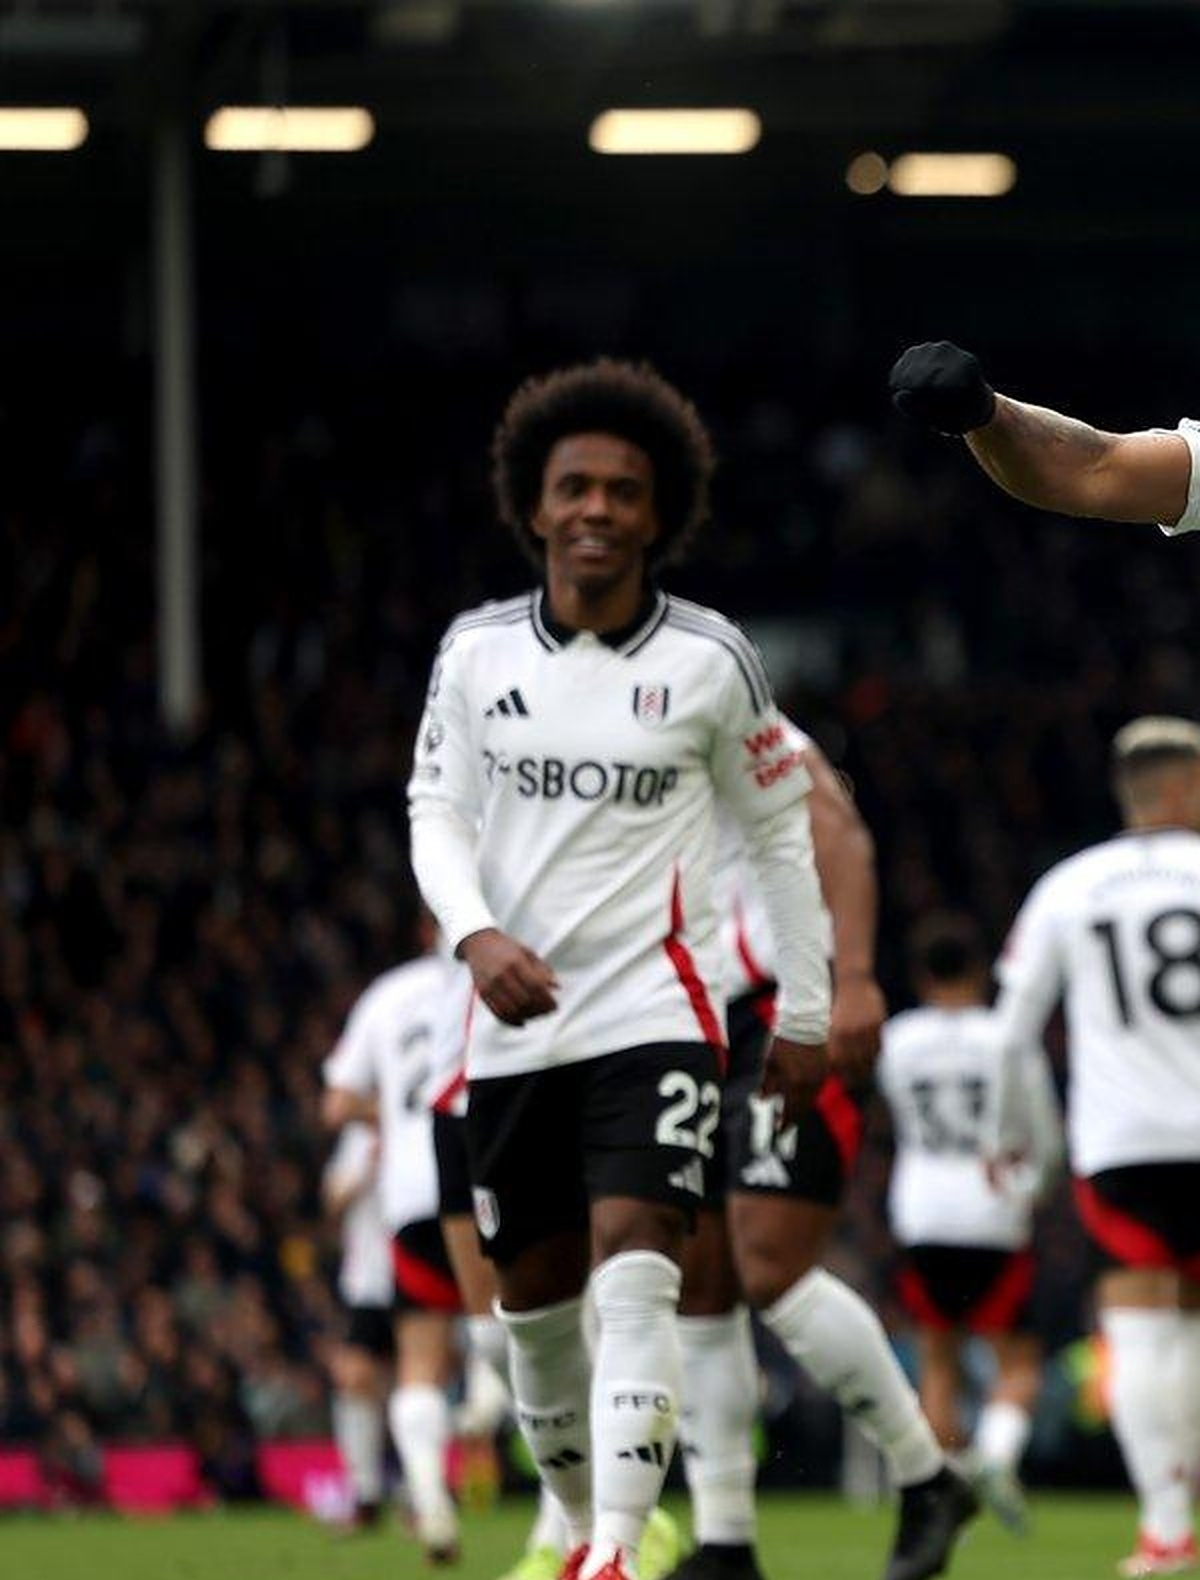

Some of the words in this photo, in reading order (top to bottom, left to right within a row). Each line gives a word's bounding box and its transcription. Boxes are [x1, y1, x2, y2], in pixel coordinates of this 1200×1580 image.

[517, 758, 678, 807] SBOTOP
[656, 1070, 721, 1159] 22
[613, 1394, 670, 1413] FFC
